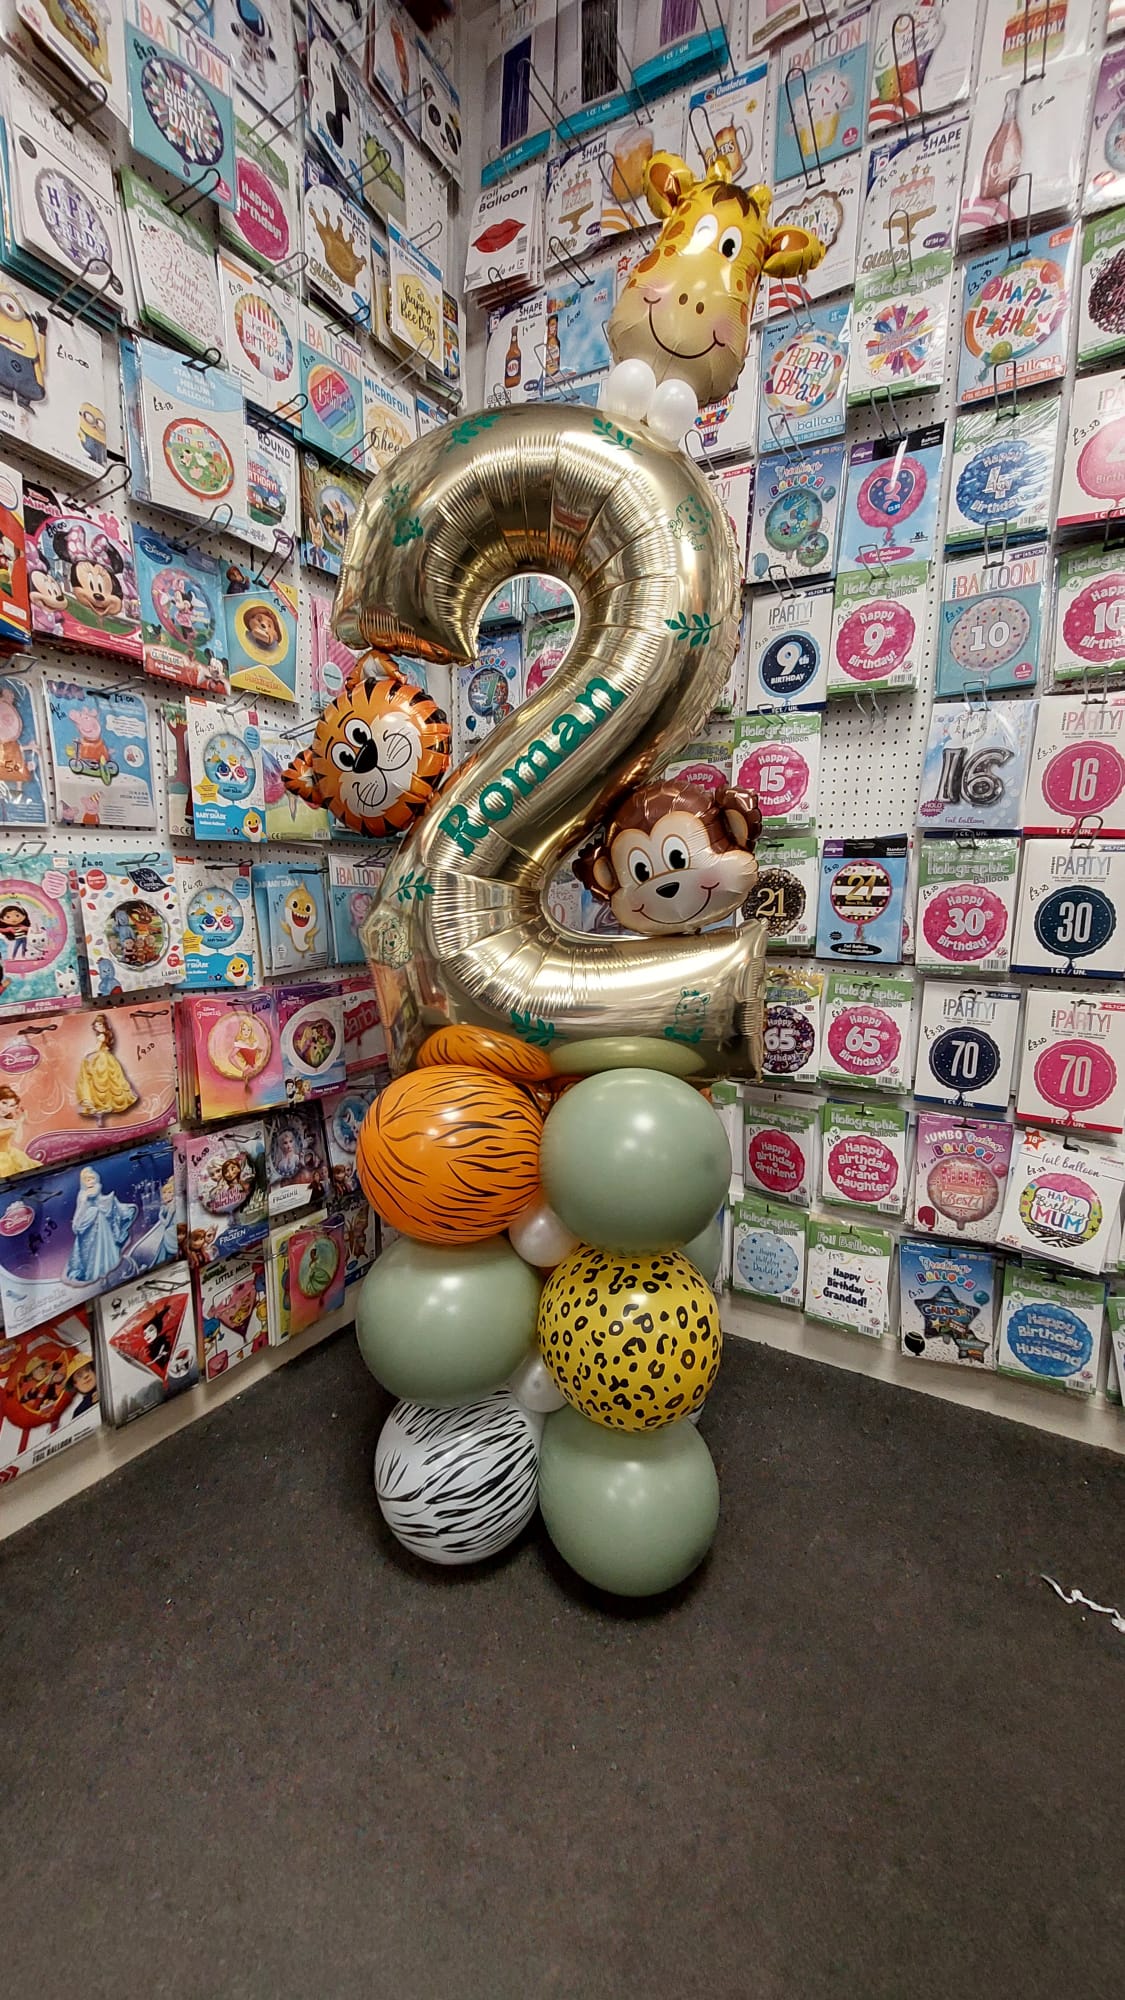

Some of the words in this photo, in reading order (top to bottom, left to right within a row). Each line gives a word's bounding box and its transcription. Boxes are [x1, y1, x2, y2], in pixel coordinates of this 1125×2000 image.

[716, 77, 747, 97] Qualatex
[922, 128, 962, 151] SHAPE
[241, 180, 274, 220] Happy
[478, 185, 528, 214] Balloon
[967, 269, 992, 297] £3.50
[999, 278, 1053, 308] HAPPY
[519, 301, 543, 317] SHAPE
[1005, 354, 1061, 378] balloon
[364, 376, 412, 418] MICROFOIL
[797, 415, 842, 431] balloon
[1072, 419, 1101, 446] £3.50
[770, 475, 825, 498] BALLOON
[843, 575, 920, 597] Holographic
[957, 560, 1036, 598] BALLOON
[772, 601, 813, 626] PARTY!
[860, 611, 895, 624] Happy
[970, 621, 1010, 652] 10
[848, 650, 897, 669] Birthday!
[770, 673, 805, 685] BIRTHDAY
[1066, 711, 1124, 731] PARTY!
[438, 677, 627, 857] Roman
[758, 755, 789, 765] Happy
[687, 773, 714, 783] Happy
[935, 747, 1014, 807] 16
[1069, 757, 1099, 801] 16
[928, 862, 1010, 880] Holographic
[1056, 856, 1112, 875] PARTY!
[845, 874, 877, 901] 21
[973, 875, 1010, 885] Balloon
[756, 888, 787, 918] 21
[947, 895, 984, 907] Happy
[1056, 901, 1093, 943] 30
[937, 935, 989, 951] Birthday!
[834, 983, 906, 1000] Holographic
[948, 999, 996, 1020] PARTY!
[767, 1019, 793, 1028] Happy
[849, 1015, 882, 1028] Happy
[1056, 1010, 1112, 1032] PARTY!
[838, 1049, 884, 1067] Birthday!
[951, 1040, 979, 1079] 70
[1059, 1054, 1092, 1097] 70
[831, 1111, 899, 1131] Holographic
[924, 1130, 962, 1144] JUMBO
[761, 1141, 790, 1157] Happy
[845, 1143, 884, 1157] Happy
[933, 1143, 995, 1164] BALLOON
[757, 1151, 796, 1170] Birthday
[839, 1154, 890, 1173] Birthday
[1062, 1159, 1100, 1178] balloon
[755, 1162, 797, 1180] Girlfriend
[844, 1168, 879, 1181] Grand
[837, 1176, 889, 1192] Daughter
[1036, 1194, 1088, 1219] Birthday
[1047, 1191, 1079, 1206] HAPPY
[739, 1208, 800, 1230] Holographic
[1034, 1205, 1082, 1233] MUM
[219, 1229, 246, 1245] FROZEN
[817, 1231, 836, 1245] Foil
[839, 1236, 883, 1256] Balloon
[833, 1267, 860, 1283] Happy
[916, 1271, 976, 1290] BALLOON
[827, 1277, 865, 1296] Birthday
[1013, 1277, 1097, 1303] Holographic
[823, 1287, 867, 1308] Grandad!
[1027, 1313, 1076, 1334] Happy
[1018, 1324, 1083, 1351] Birthday
[1016, 1343, 1082, 1367] Husband
